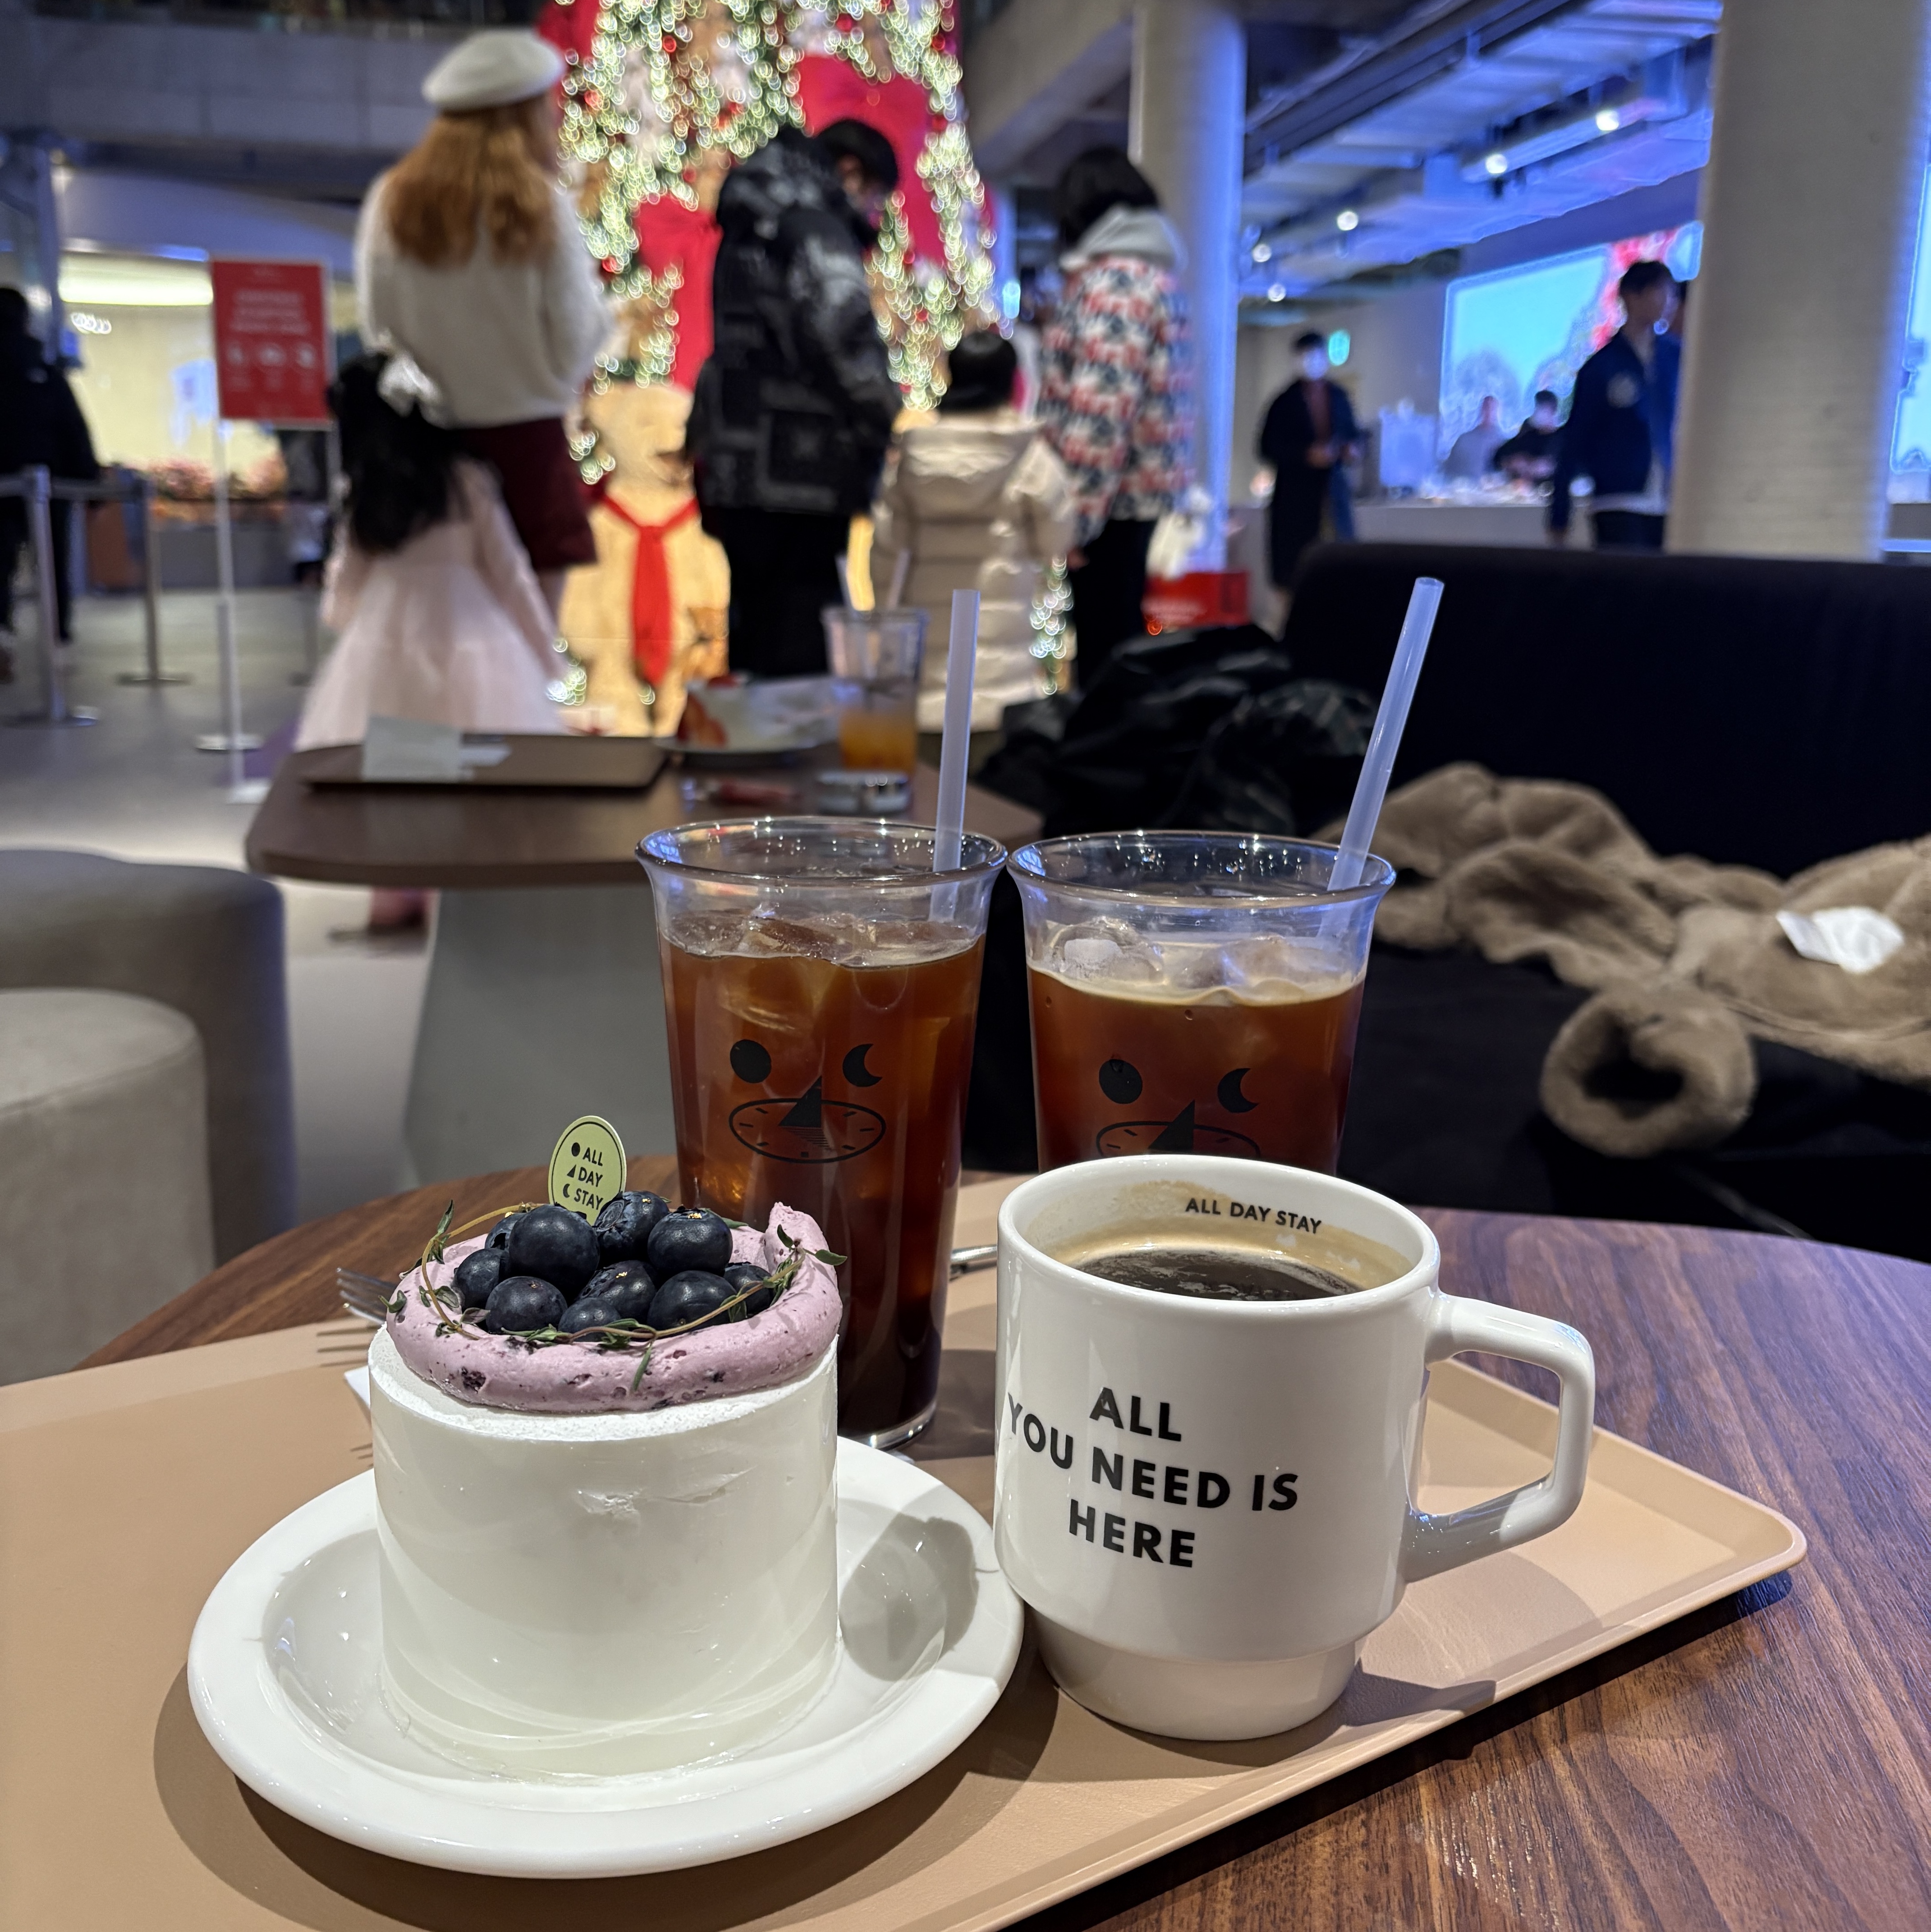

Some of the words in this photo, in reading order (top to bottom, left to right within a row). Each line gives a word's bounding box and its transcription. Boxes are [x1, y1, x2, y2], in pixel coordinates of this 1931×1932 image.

[583, 1147, 603, 1166] ALL
[578, 1166, 603, 1187] DAY
[574, 1188, 604, 1210] STAY
[1185, 1198, 1221, 1215] ALL
[1230, 1202, 1271, 1222] DAY
[1275, 1210, 1322, 1234] STAY
[1089, 1387, 1182, 1442] ALL
[1007, 1393, 1073, 1469] YOU
[1092, 1446, 1231, 1509] NEED
[1252, 1473, 1298, 1511] IS
[1069, 1498, 1196, 1568] HERE
